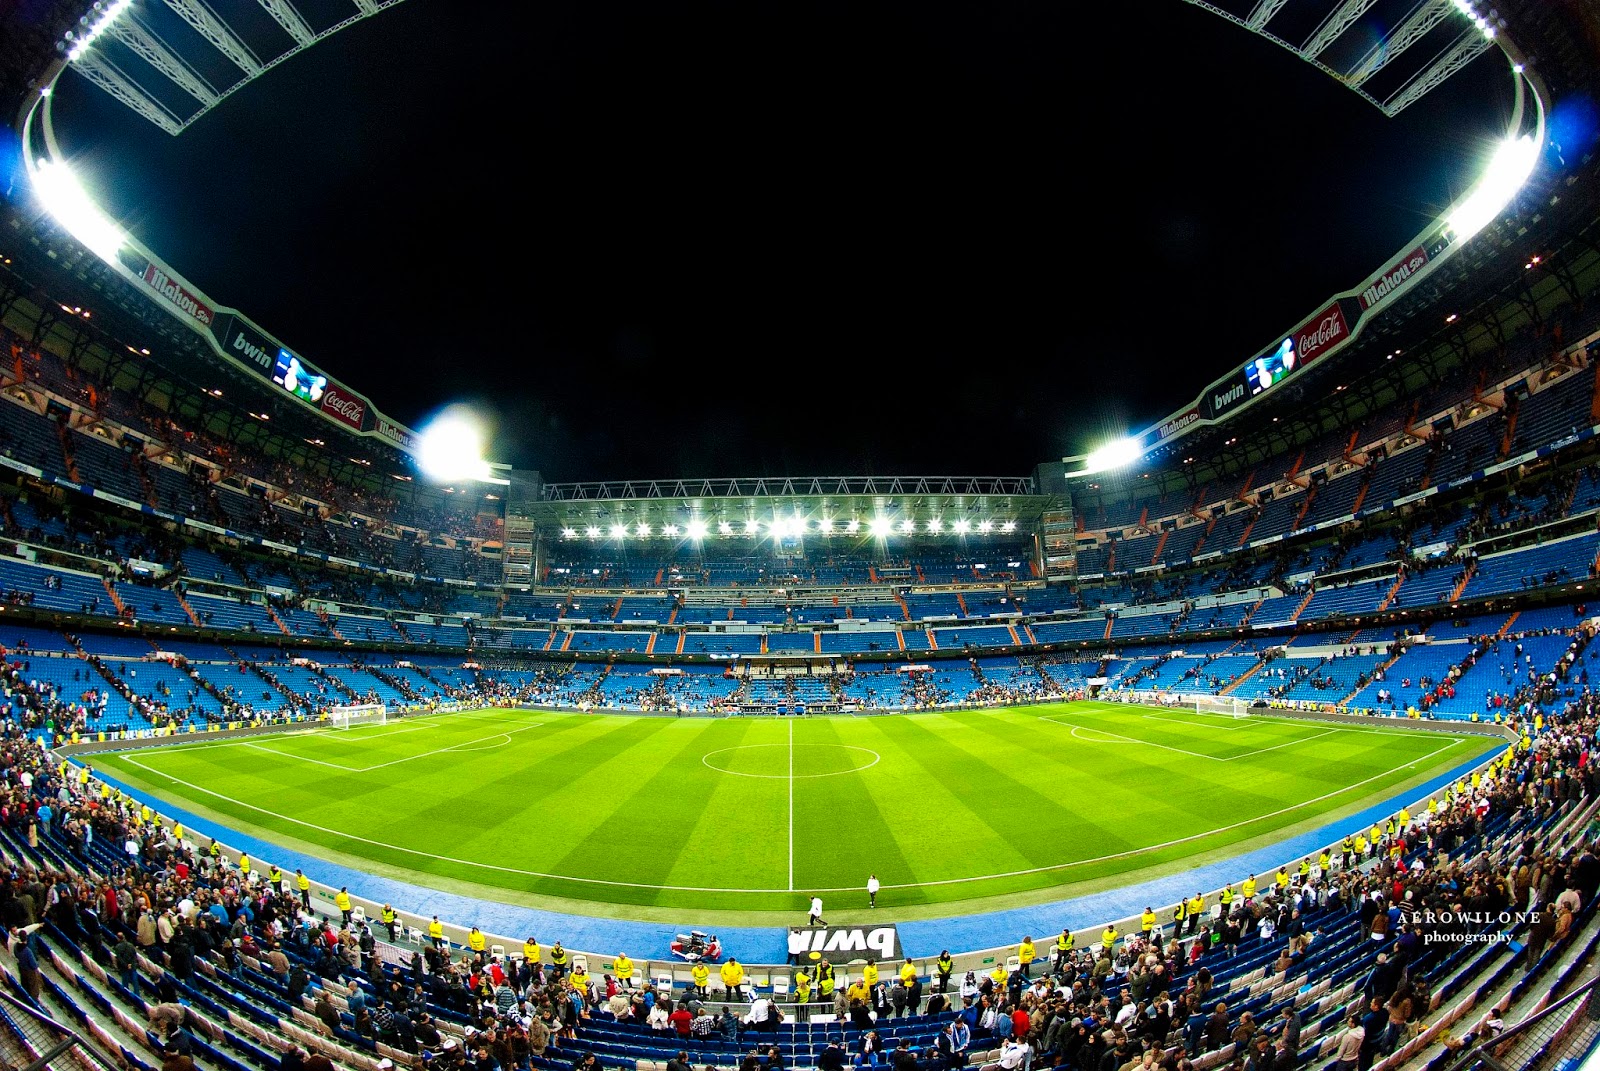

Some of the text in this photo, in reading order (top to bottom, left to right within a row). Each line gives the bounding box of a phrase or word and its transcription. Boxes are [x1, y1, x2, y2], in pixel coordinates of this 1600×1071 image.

[150, 267, 198, 316] Mahou
[1362, 265, 1410, 307] Mahou
[233, 333, 272, 368] bwin
[1215, 384, 1244, 410] bwin
[379, 420, 408, 446] Mahou
[1159, 416, 1190, 439] Mahou
[790, 927, 896, 961] bwin
